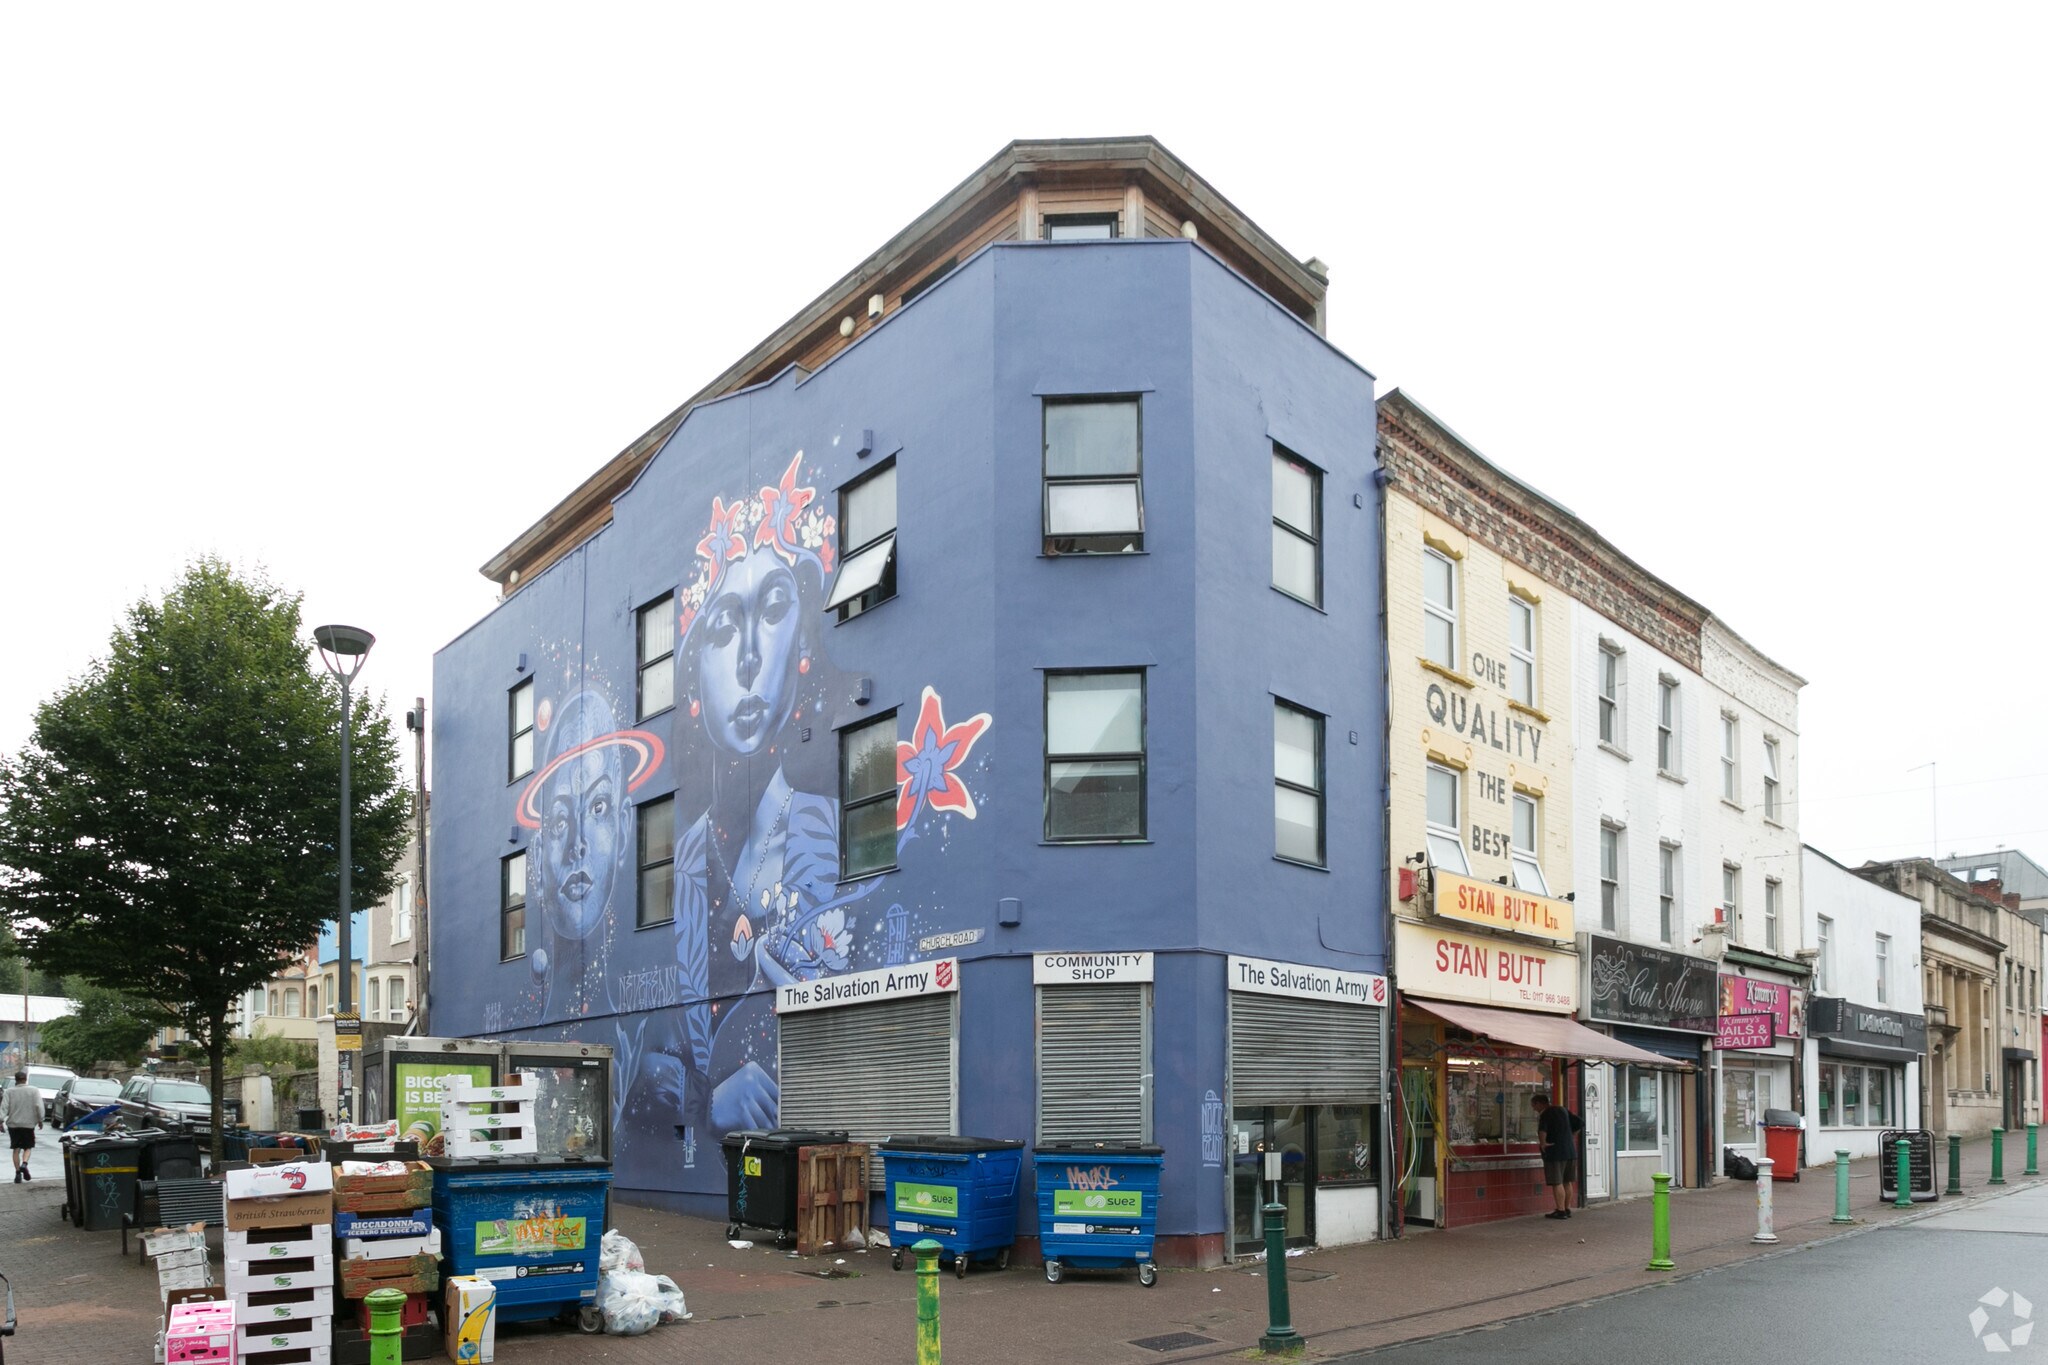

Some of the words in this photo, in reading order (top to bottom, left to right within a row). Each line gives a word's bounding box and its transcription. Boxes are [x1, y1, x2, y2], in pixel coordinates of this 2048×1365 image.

[1473, 652, 1506, 690] ONE
[1426, 683, 1542, 764] QUALITY
[1477, 770, 1505, 805] THE
[1472, 824, 1511, 860] BEST
[1458, 884, 1495, 917] STAN
[1504, 895, 1538, 925] BUTT
[921, 936, 951, 950] CHURCH
[953, 931, 975, 944] ROAD
[1044, 955, 1142, 969] COMMUNITY
[1072, 967, 1116, 980] SHOP
[1436, 939, 1488, 979] STAN
[1498, 951, 1546, 986] BUTT
[785, 988, 809, 1006] The
[814, 979, 880, 1003] Salvation
[885, 972, 928, 992] Army
[1238, 963, 1265, 985] The
[1270, 967, 1331, 993] Salvation
[1335, 976, 1369, 1001] Army
[1629, 967, 1658, 1008] Cut
[1659, 957, 1703, 1015] Above
[1533, 991, 1543, 1002] 0117
[1545, 993, 1555, 1003] 966
[1746, 980, 1779, 1011] Kimmy's
[1717, 1024, 1754, 1035] NAILS
[1758, 1025, 1767, 1034] &
[1722, 1015, 1760, 1026] Kimmy's
[1714, 1036, 1768, 1047] BEAUTY
[405, 1091, 420, 1103] IS
[235, 1209, 266, 1220] British
[268, 1206, 326, 1219] Strawberries
[350, 1219, 414, 1230] RICCADONNA
